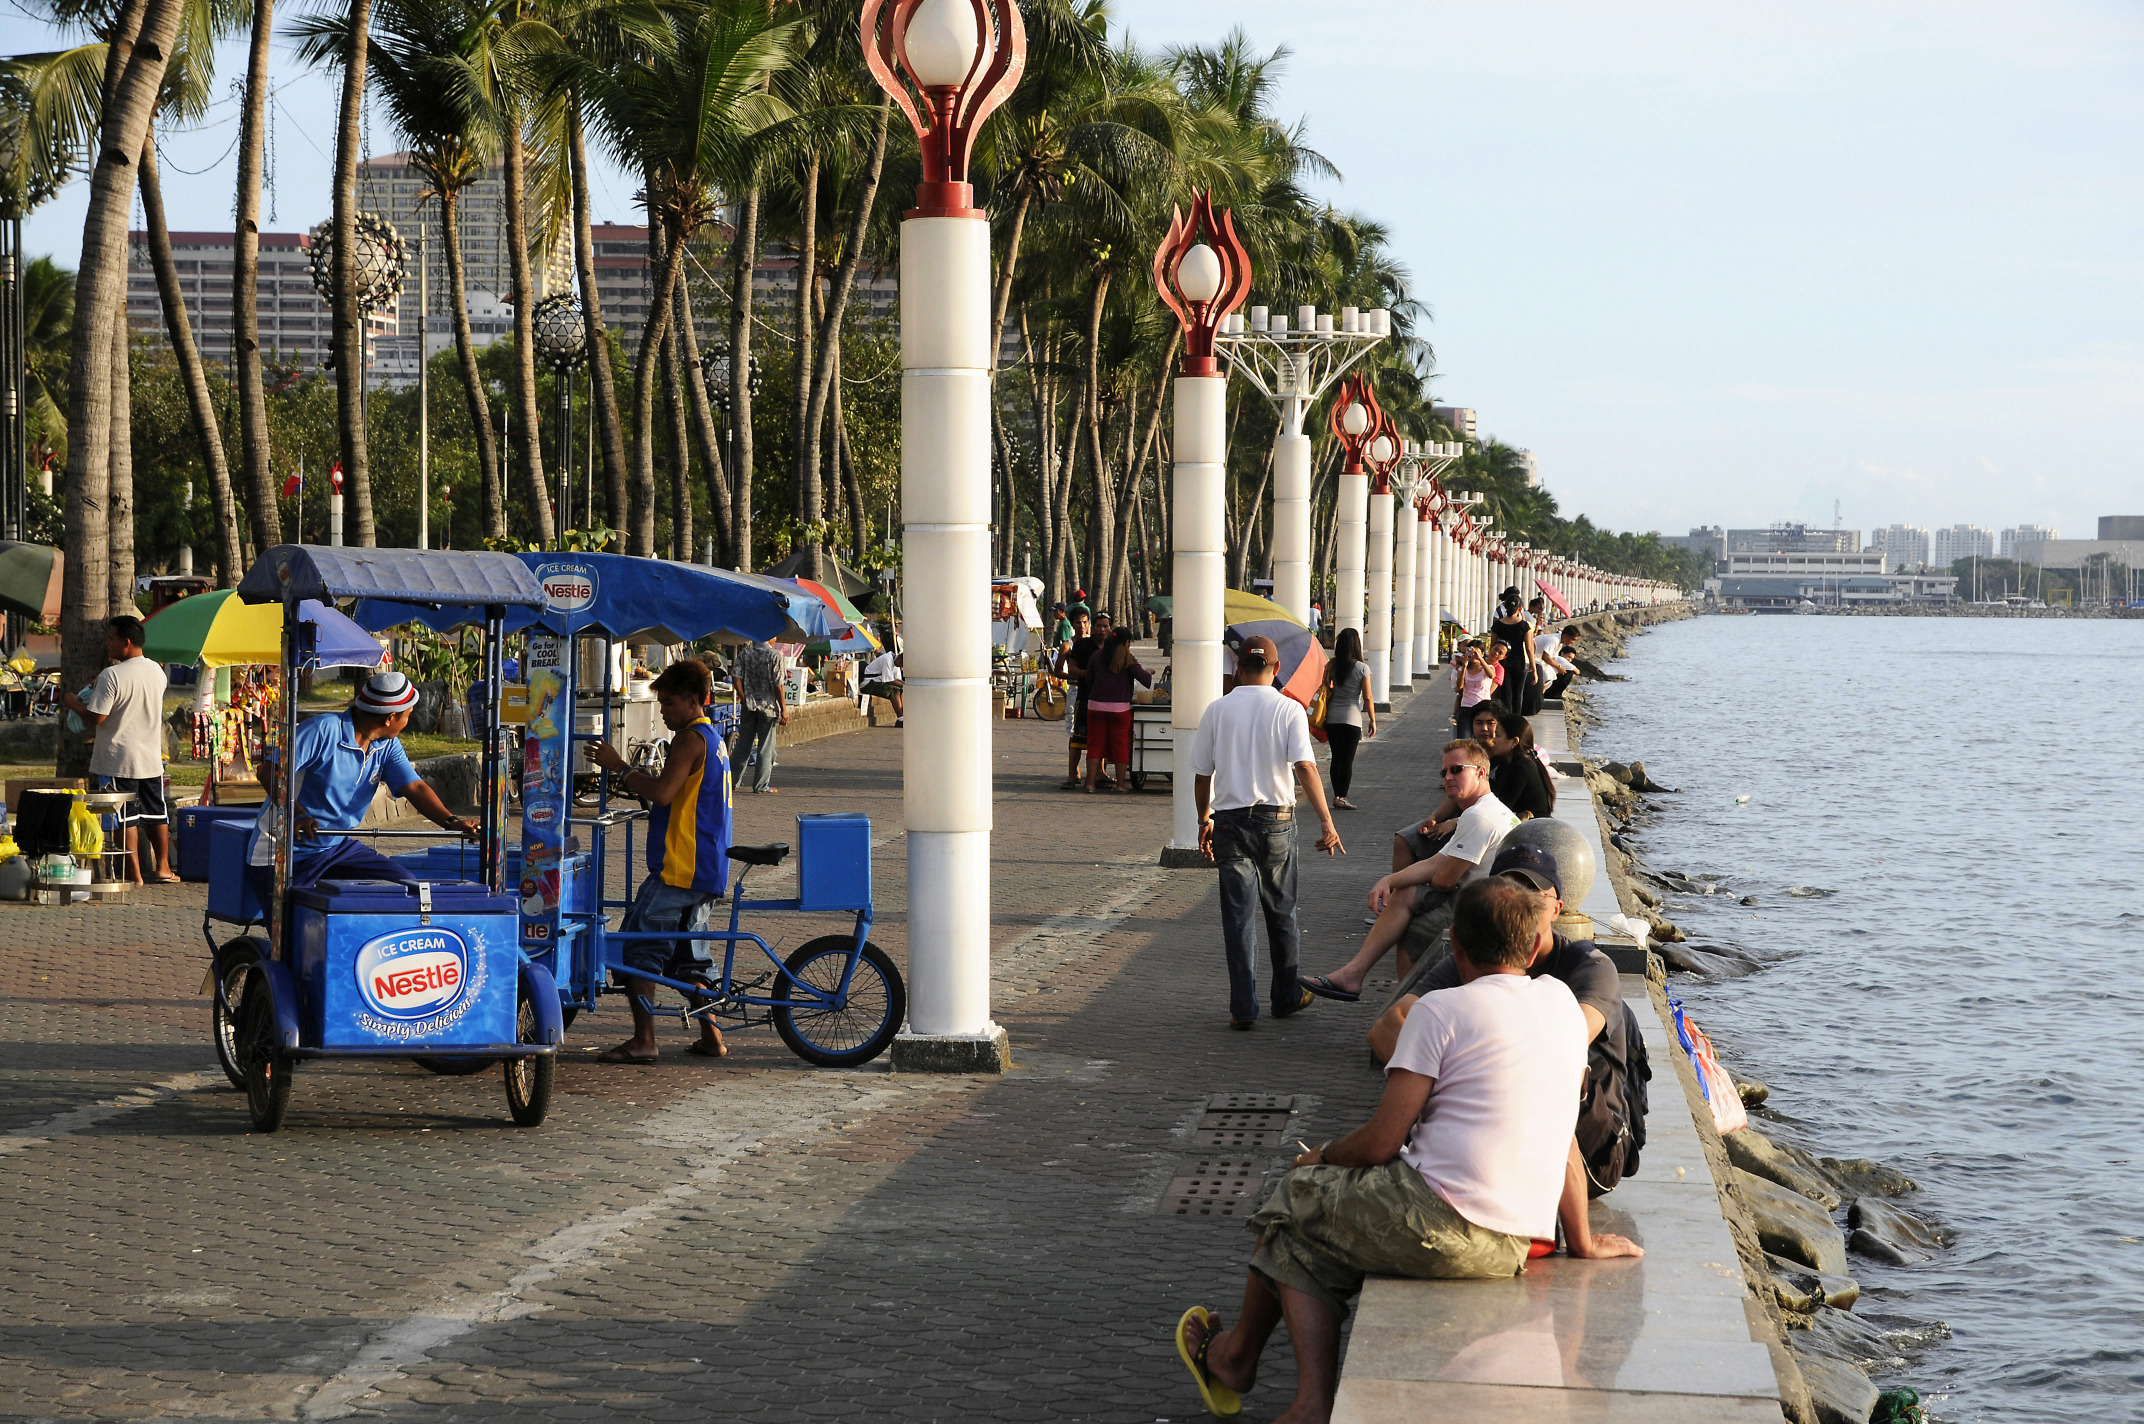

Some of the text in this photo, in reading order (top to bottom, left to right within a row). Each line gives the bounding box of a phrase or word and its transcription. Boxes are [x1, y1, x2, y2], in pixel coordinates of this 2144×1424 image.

[547, 564, 587, 575] ICE CREAM
[532, 642, 542, 650] Go
[544, 641, 555, 649] for
[537, 650, 557, 658] COOL
[378, 938, 446, 959] ICE CREAM
[360, 996, 472, 1040] Simply Delicious
